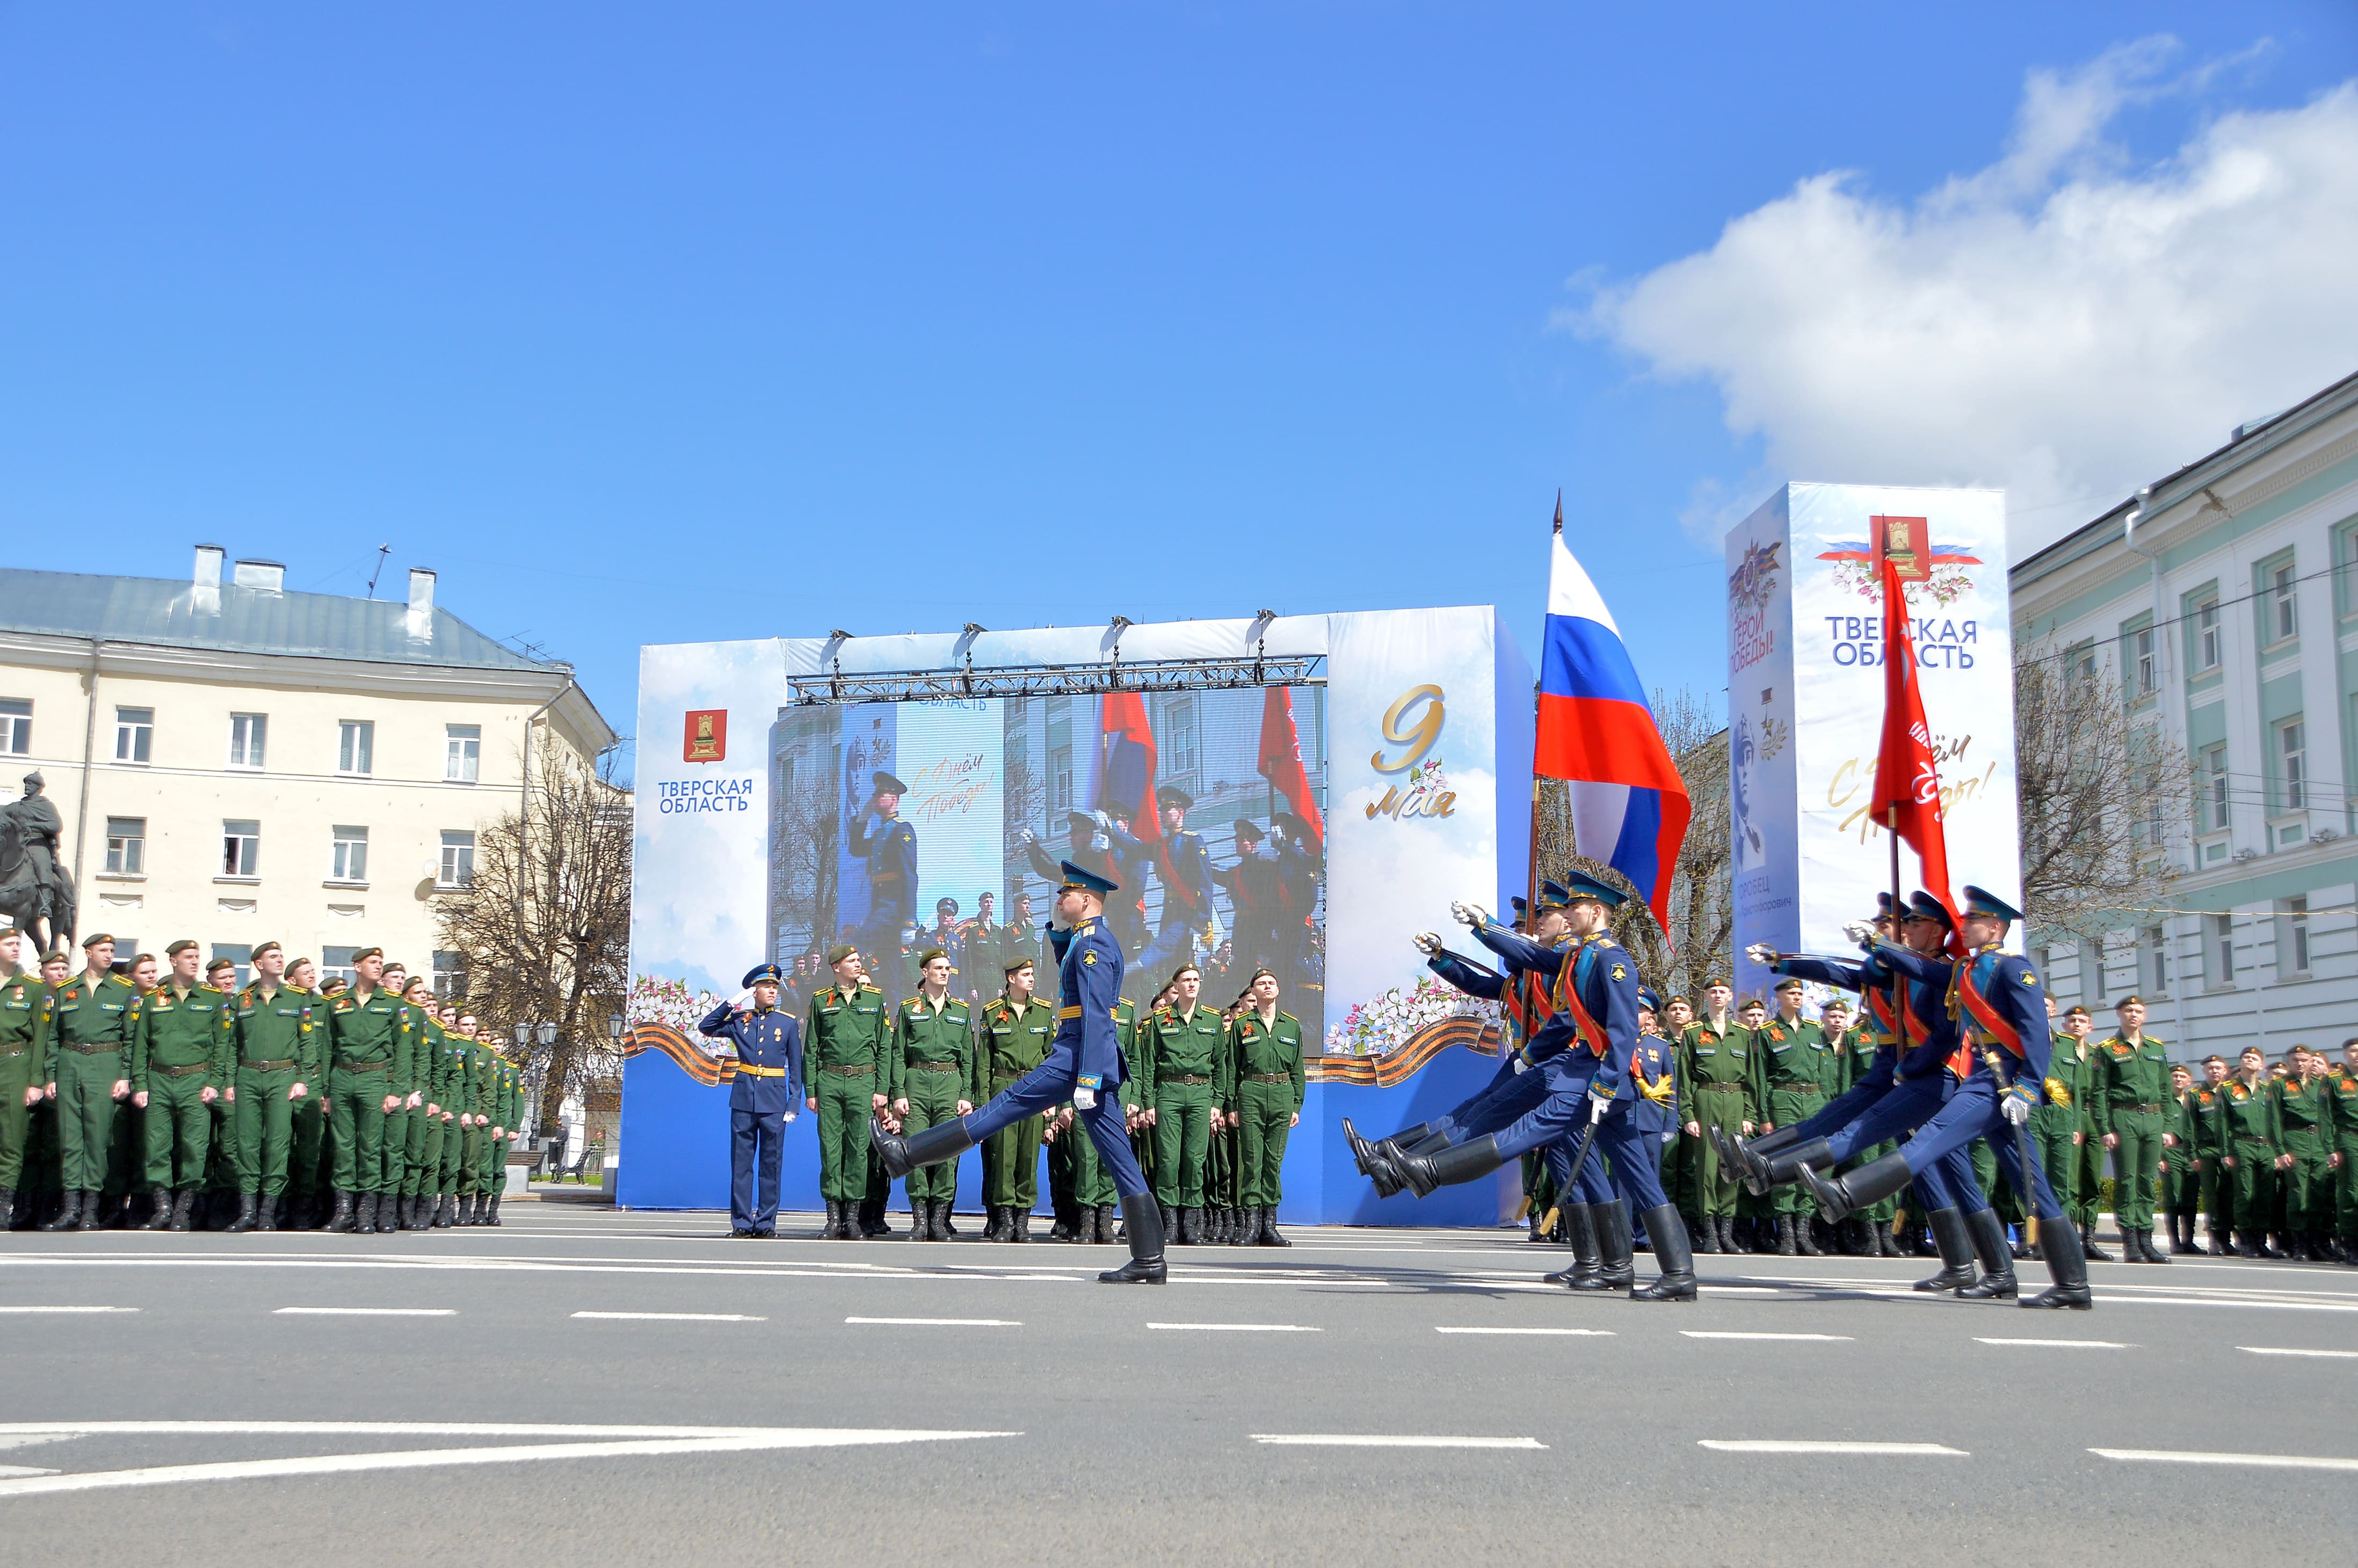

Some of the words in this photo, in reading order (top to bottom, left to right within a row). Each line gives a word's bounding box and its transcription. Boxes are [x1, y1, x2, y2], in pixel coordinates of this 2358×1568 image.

[1825, 616, 1976, 644] ТВЕКАЯ
[1730, 630, 1774, 677] ПОБЕДЫ!
[1833, 642, 1974, 669] ОБСТЬ
[1371, 684, 1443, 772] 9
[658, 779, 752, 797] ТВЕРСКАЯ
[911, 766, 928, 798] С
[931, 753, 984, 786] Днём
[660, 795, 748, 814] ОБЛАСТЬ
[916, 772, 995, 824] Победы!
[1366, 785, 1456, 821] Мая
